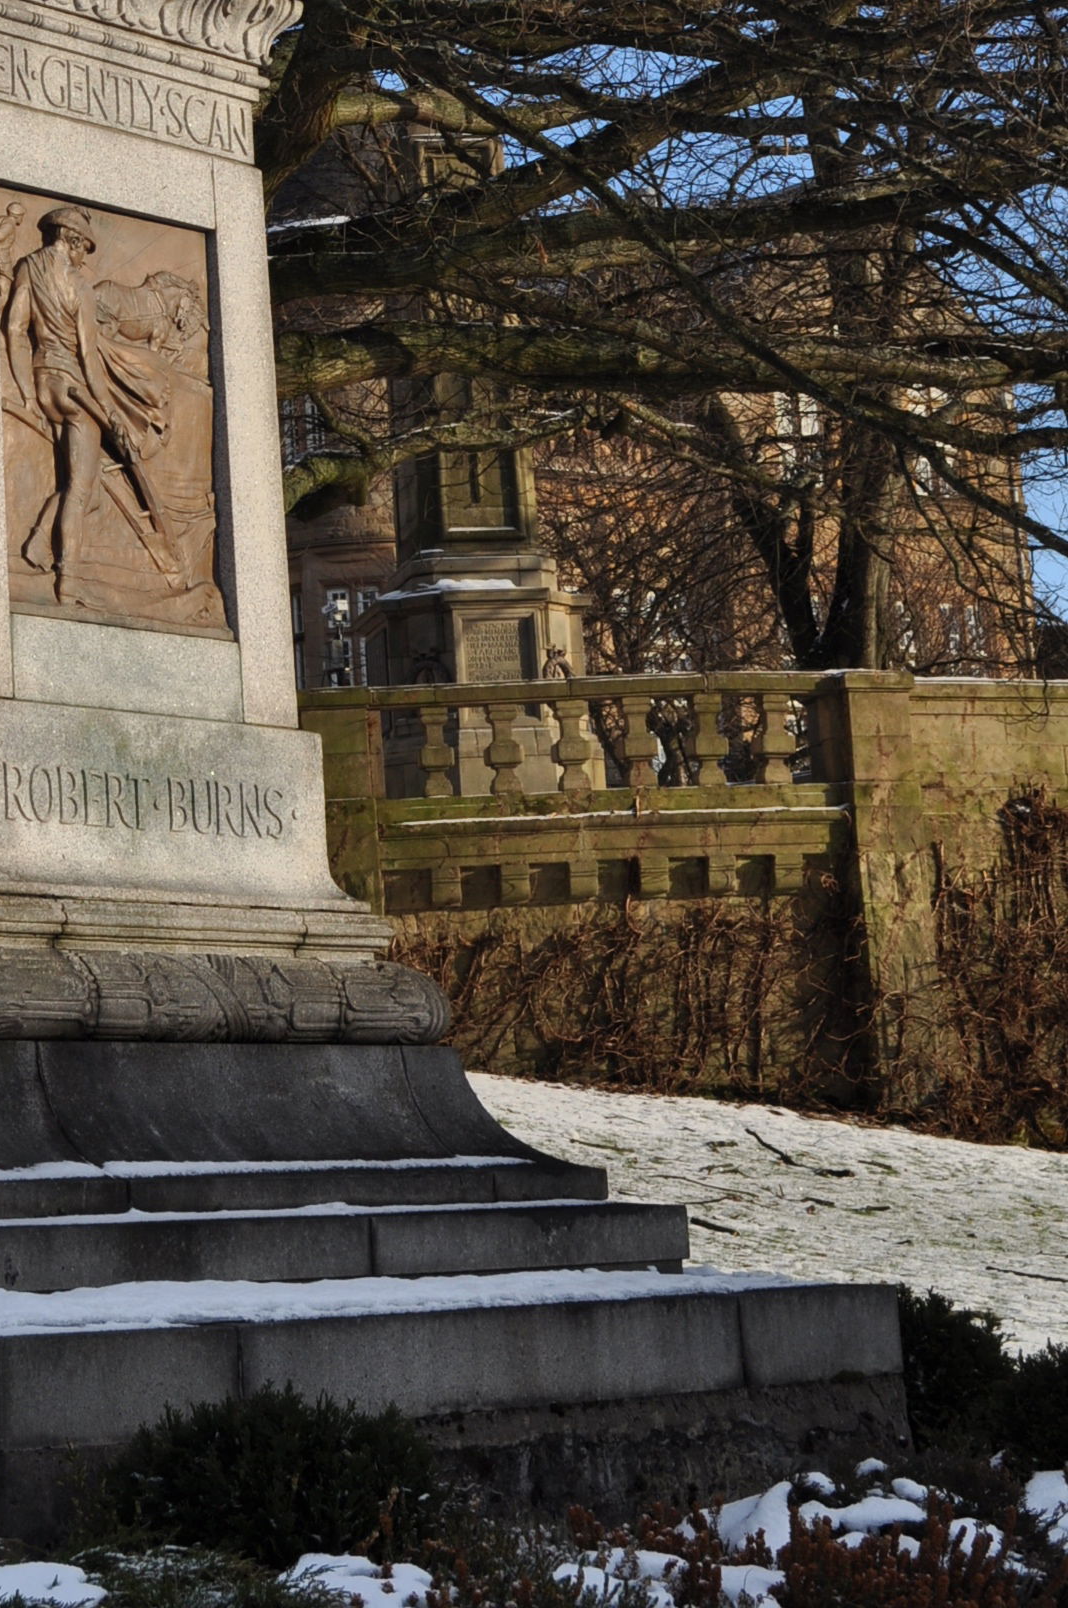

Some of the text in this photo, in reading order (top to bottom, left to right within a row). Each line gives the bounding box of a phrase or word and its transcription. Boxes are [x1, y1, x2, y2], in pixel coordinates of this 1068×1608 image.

[41, 55, 160, 134] GENTLY
[166, 87, 248, 156] SCAN
[2, 761, 283, 839] ROBERT BURNS
